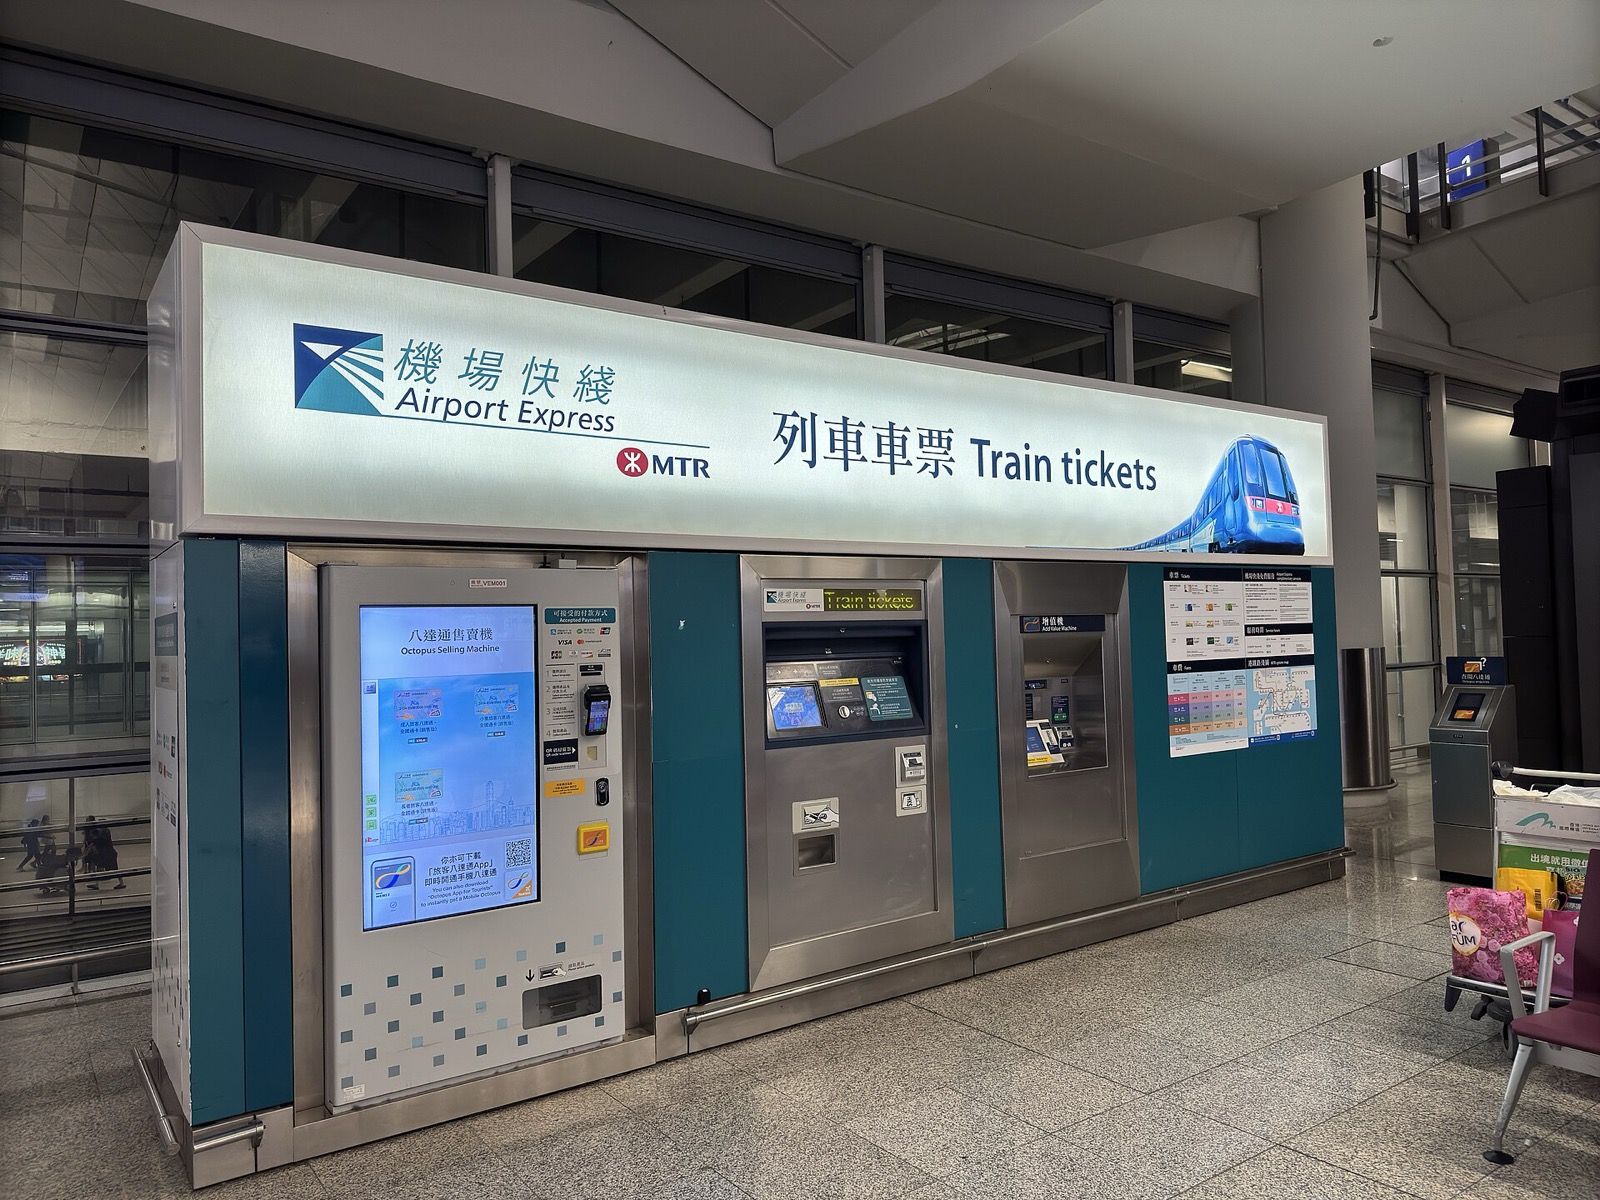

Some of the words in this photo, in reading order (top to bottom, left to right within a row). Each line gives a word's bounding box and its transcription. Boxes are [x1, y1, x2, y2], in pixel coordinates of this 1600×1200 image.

[393, 338, 616, 406] 機場快綫
[394, 387, 509, 422] Airport
[518, 400, 616, 433] Express
[772, 409, 956, 479] 列車車票
[652, 454, 711, 479] MTR
[969, 437, 1052, 484] Train
[1061, 447, 1157, 492] tickets
[824, 591, 864, 608] Train
[868, 592, 914, 608] tickets
[554, 609, 608, 617] 可接受的付款方式
[1042, 616, 1064, 626] 增值機
[408, 628, 493, 642] 八達通售賣機
[400, 646, 436, 655] Octopus
[438, 646, 465, 654] Selling
[440, 852, 482, 865] 你亦可下載
[424, 868, 497, 887] 即時開通手機八達通
[464, 880, 488, 888] download
